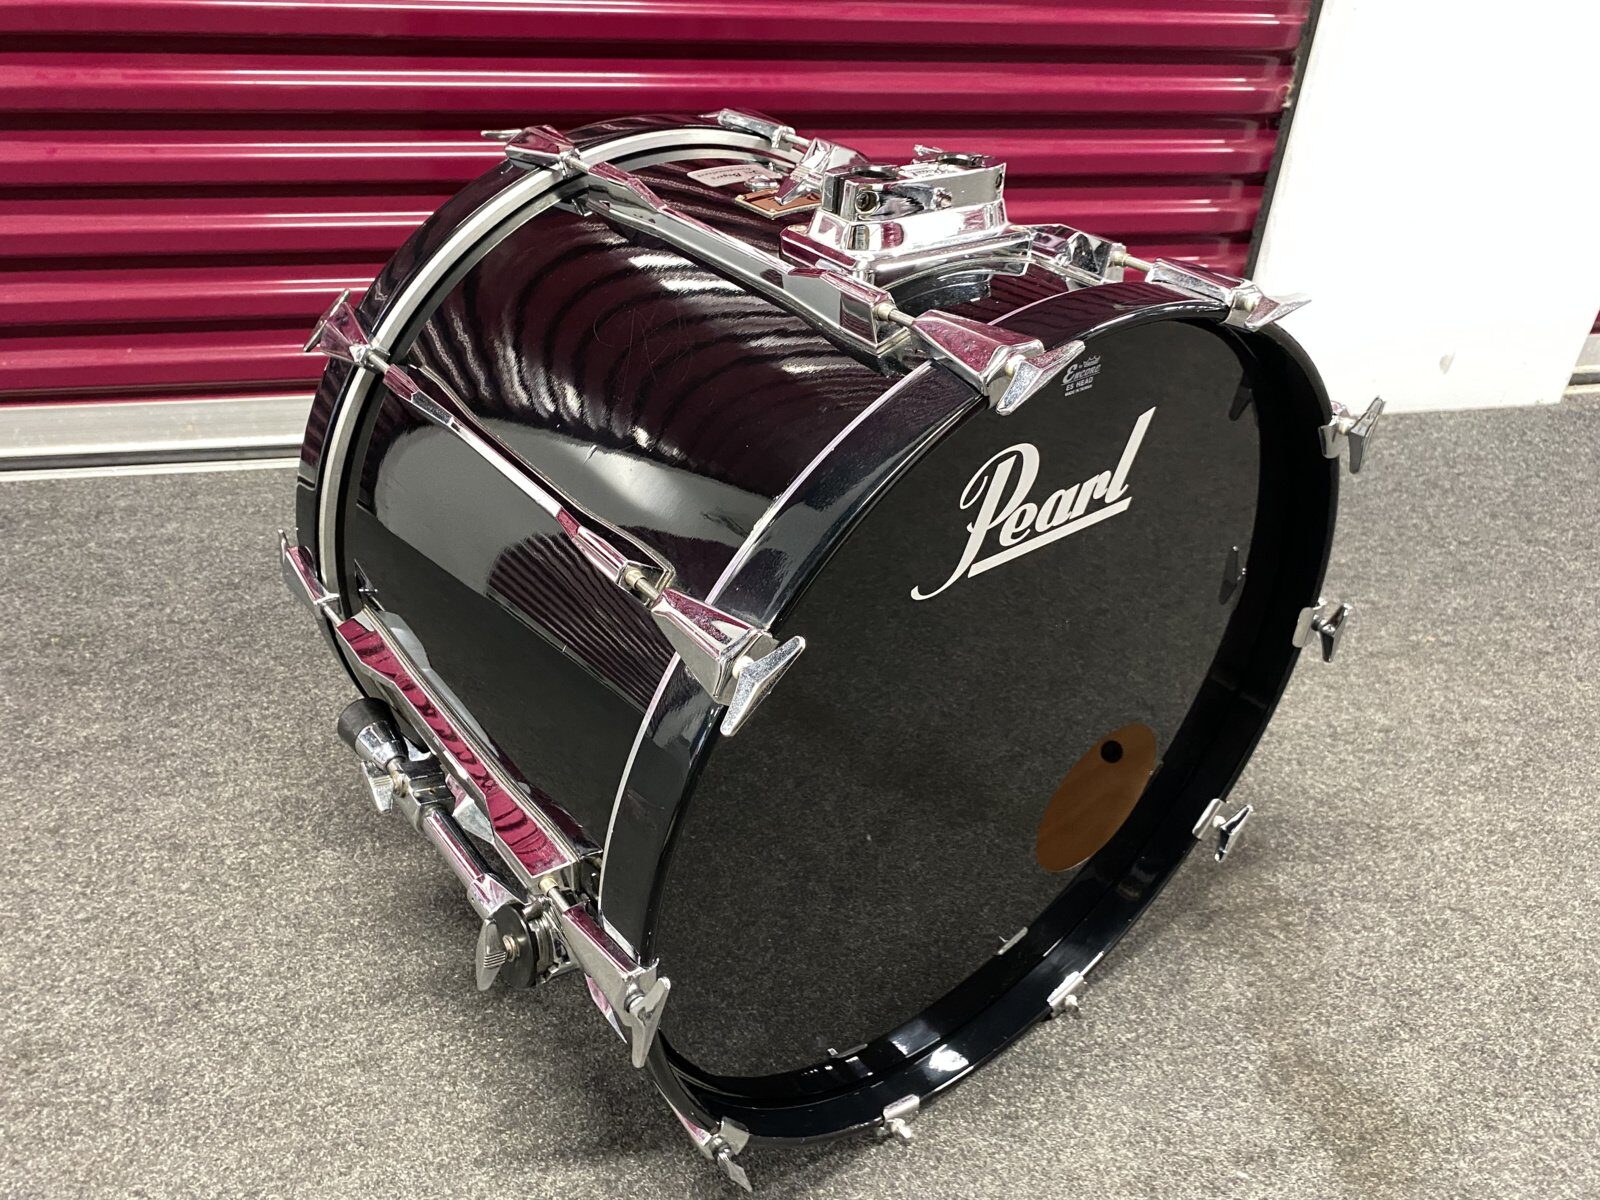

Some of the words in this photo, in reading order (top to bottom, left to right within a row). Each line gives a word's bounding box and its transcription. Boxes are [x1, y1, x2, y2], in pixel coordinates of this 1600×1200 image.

[1066, 383, 1074, 391] ES
[1075, 377, 1093, 388] HEAD
[910, 406, 1156, 601] Pearl
